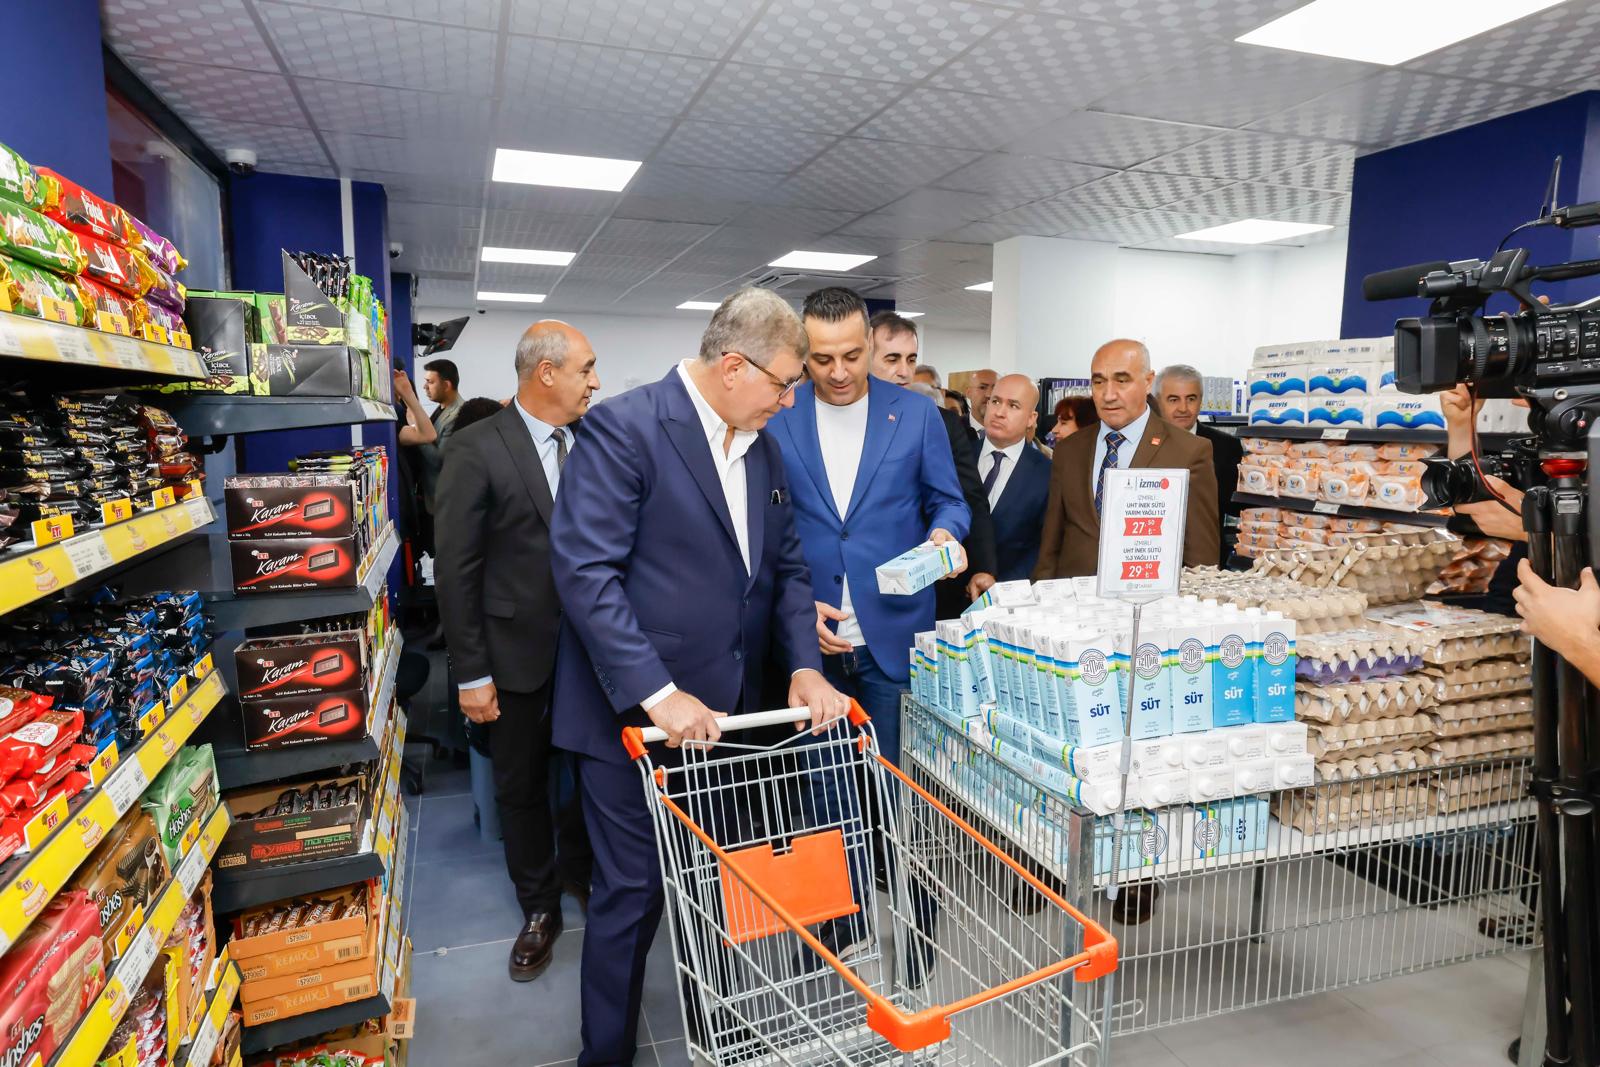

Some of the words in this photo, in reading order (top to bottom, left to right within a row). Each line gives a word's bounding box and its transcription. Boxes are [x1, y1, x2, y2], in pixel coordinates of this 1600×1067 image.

[250, 501, 300, 524] Karam
[256, 552, 304, 576] Karam
[261, 659, 309, 684] Karam
[1224, 686, 1244, 700] SÜT
[1267, 683, 1287, 696] SÜT
[1140, 697, 1161, 711] SÜT
[1184, 691, 1203, 705] SÜT
[1090, 703, 1111, 718] SÜT
[268, 709, 315, 732] Karam
